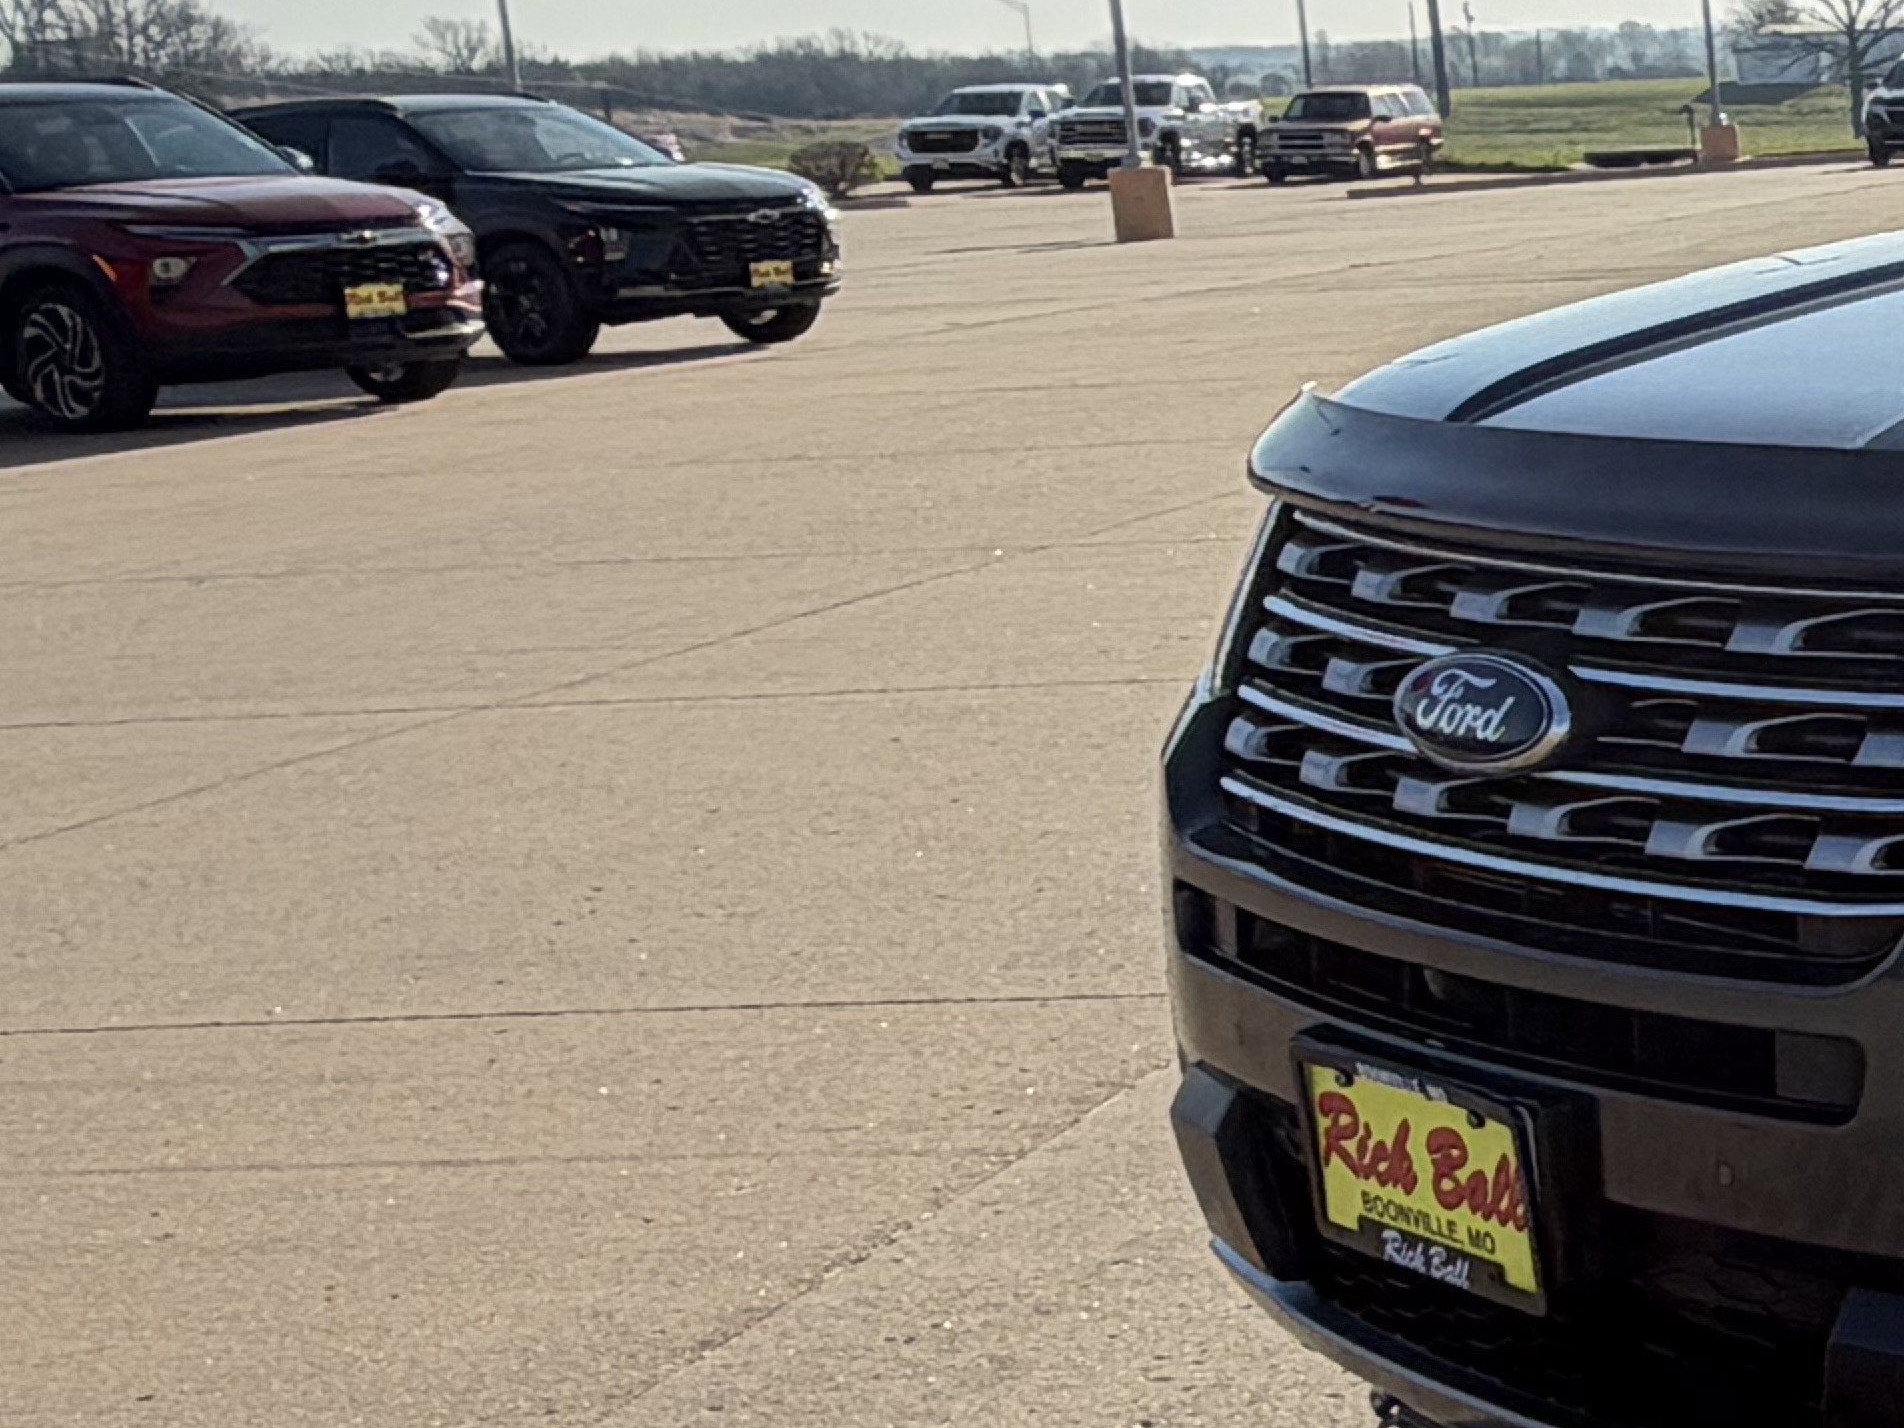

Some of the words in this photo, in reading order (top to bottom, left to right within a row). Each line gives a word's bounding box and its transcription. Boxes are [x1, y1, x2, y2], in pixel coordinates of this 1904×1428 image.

[1417, 669, 1515, 742] Ford
[1318, 1091, 1417, 1195] Rick
[1426, 1127, 1529, 1232] Ball
[1361, 1190, 1461, 1242] BOONVILLE
[1467, 1224, 1496, 1255] MO
[1381, 1228, 1426, 1273] Rick
[1429, 1246, 1469, 1289] Ball
